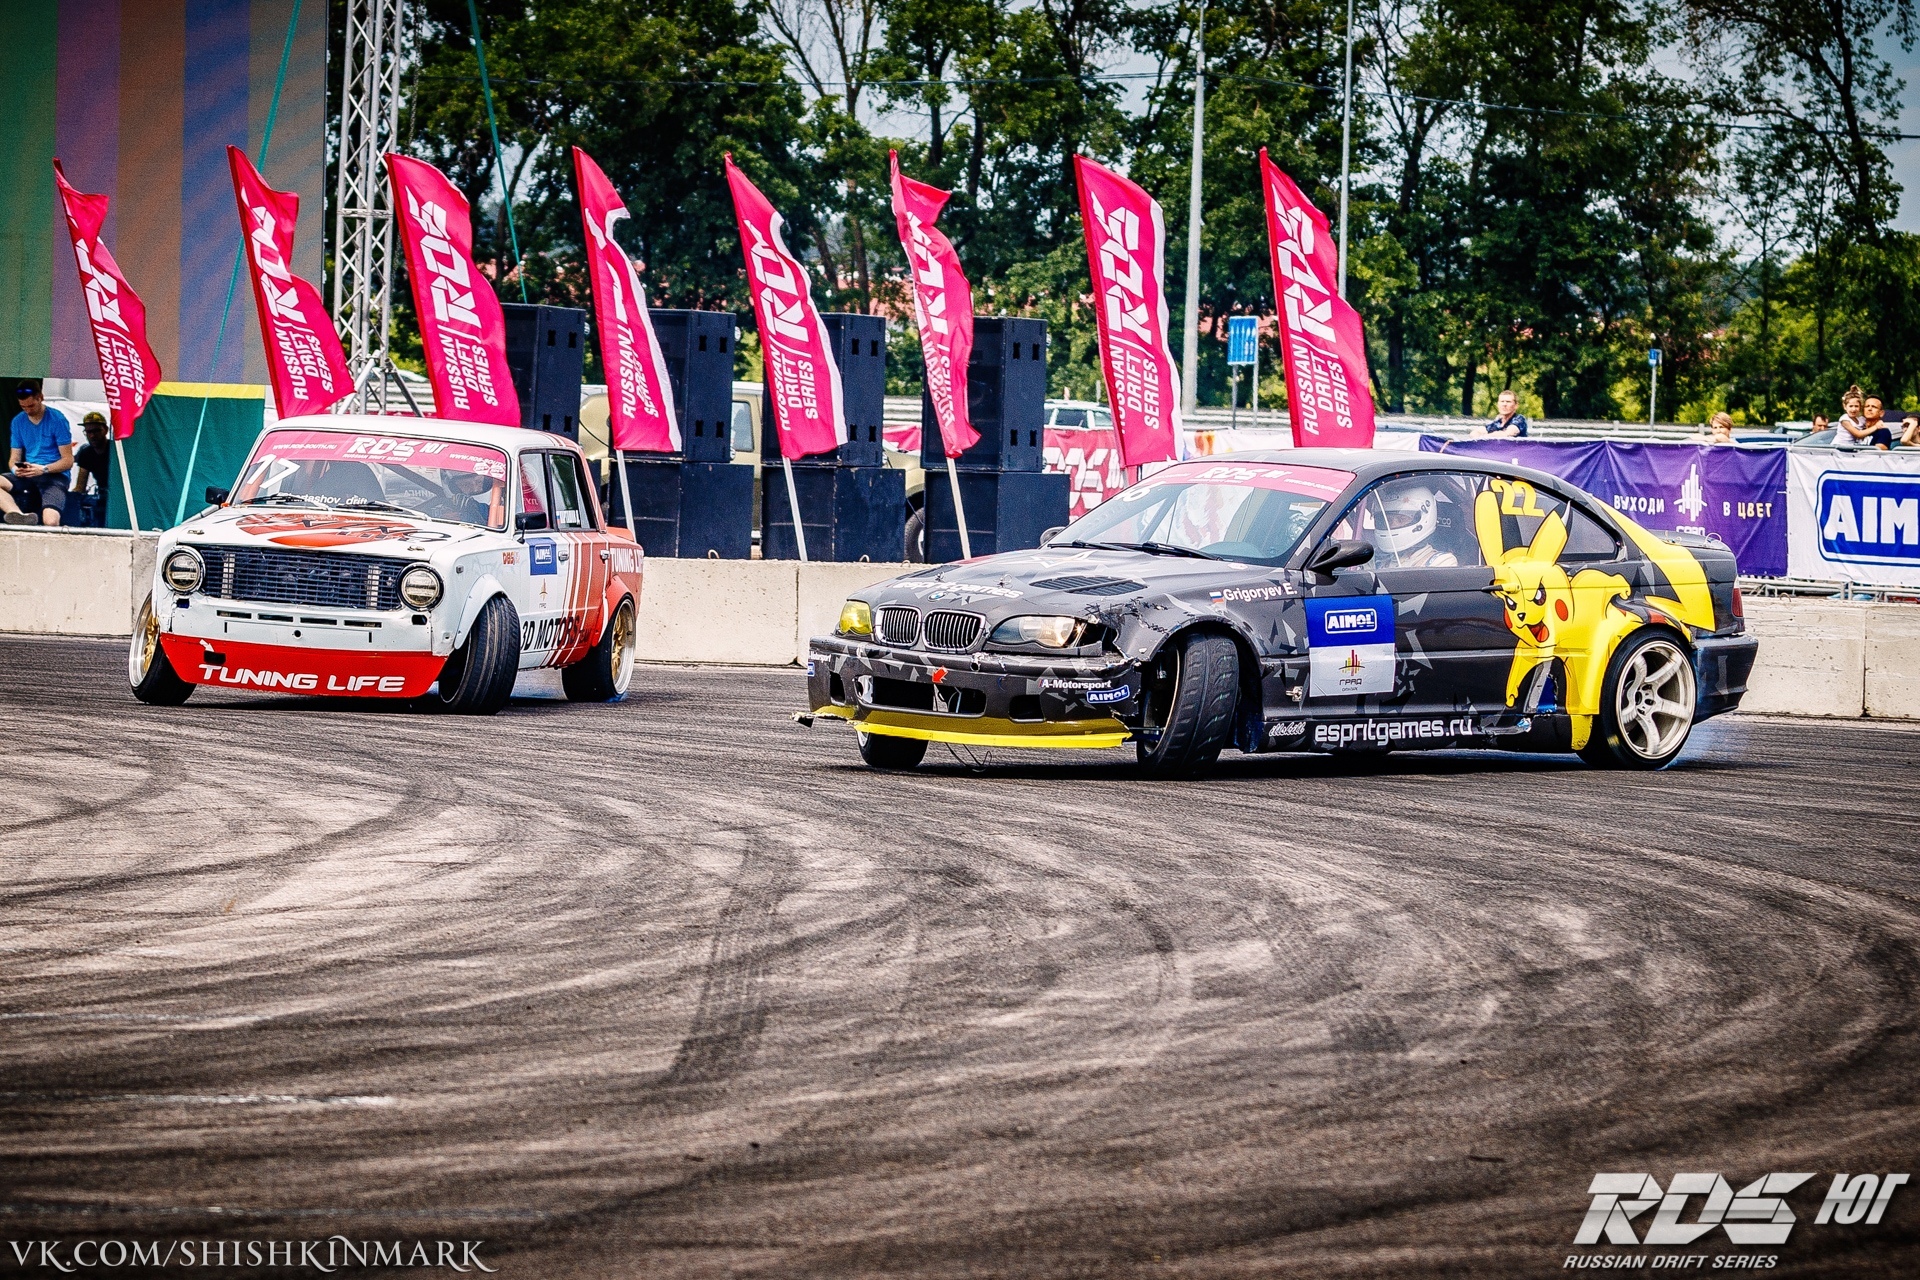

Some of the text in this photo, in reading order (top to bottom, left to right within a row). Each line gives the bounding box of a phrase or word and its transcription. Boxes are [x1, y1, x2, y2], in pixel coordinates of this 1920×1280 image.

[404, 184, 482, 329] RDS
[96, 332, 121, 410] RUSSIAN
[111, 337, 135, 389] DRIFT
[126, 344, 146, 408] SERIES
[275, 331, 309, 400] RUSSIAN
[290, 331, 320, 378] DRIFT
[306, 334, 334, 394] SERIES
[438, 333, 471, 410] RUSSIAN
[454, 338, 480, 392] DRIFT
[471, 344, 498, 406] SERIES
[617, 333, 637, 419] RUSSIAN
[781, 352, 803, 409] DRIFT
[1126, 350, 1143, 413] DRIFT
[1310, 350, 1334, 413] DRIFT
[797, 360, 819, 419] SERIES
[1109, 344, 1126, 434] USSIAN
[1142, 358, 1160, 430] SERIES
[1292, 343, 1320, 436] RUSSIAN
[1326, 360, 1354, 429] SERIES
[247, 453, 301, 489] 17
[346, 436, 423, 458] RDS
[1490, 479, 1546, 518] 22
[1613, 494, 1773, 520] ВЫХОДИ В ЦВЕТ
[1223, 582, 1298, 603] Grigoryev E.
[520, 620, 536, 651] 3D
[534, 616, 580, 650] MOTORS
[1327, 613, 1375, 630] AIMOL
[199, 663, 406, 692] TUNING LIFE
[1041, 679, 1112, 690] A-Motorsport
[1089, 688, 1129, 701] AIMOL
[1338, 678, 1363, 686] ГРАД
[1314, 718, 1474, 748] espritgames.ru
